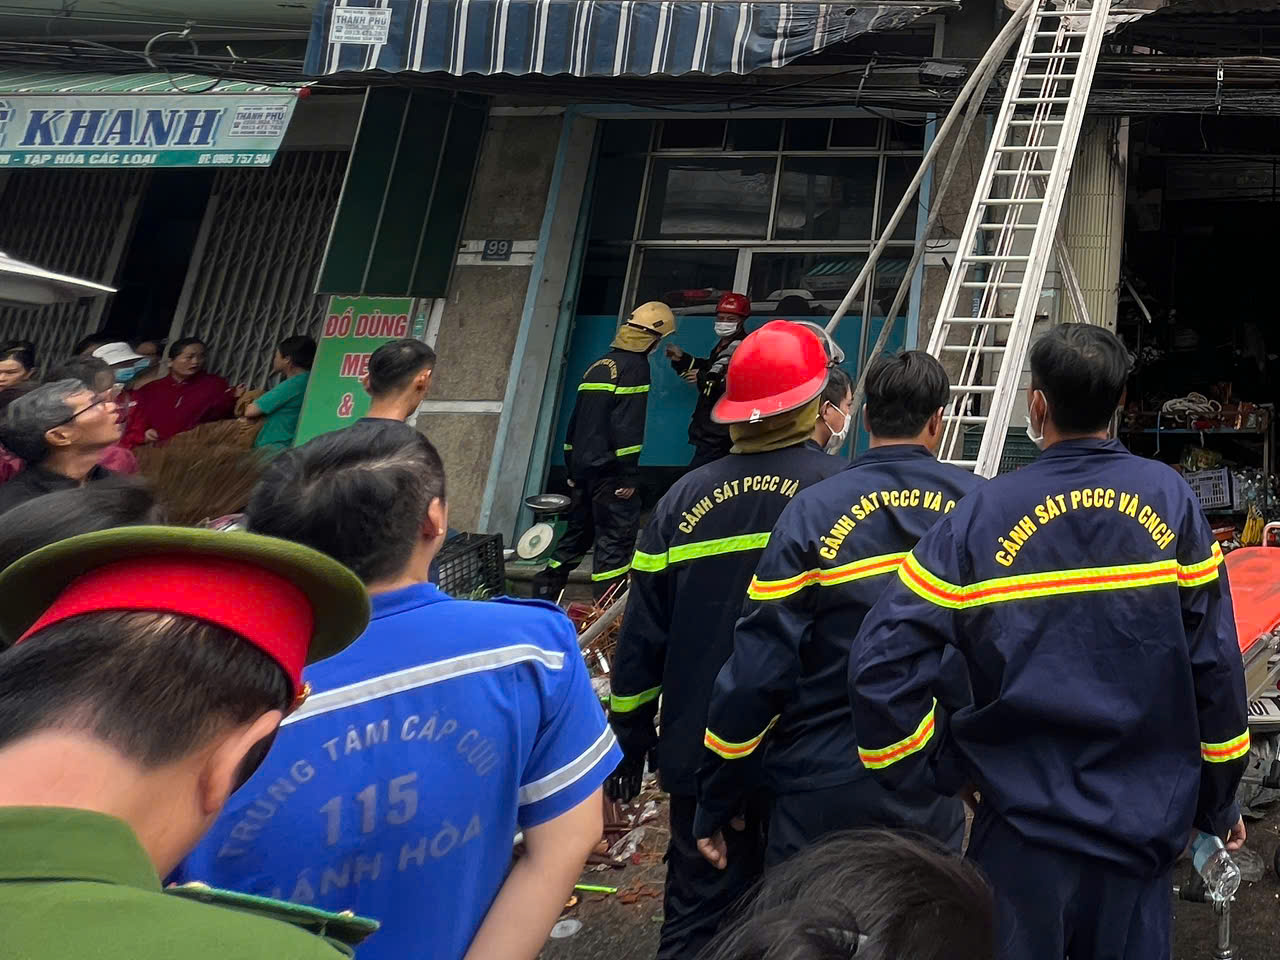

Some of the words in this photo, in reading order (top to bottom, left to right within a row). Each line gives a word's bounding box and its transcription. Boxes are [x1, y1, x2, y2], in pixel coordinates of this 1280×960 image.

[18, 109, 222, 146] KHANH
[24, 153, 52, 166] TẠP
[88, 151, 120, 164] CÁC
[121, 153, 158, 166] LOẠI
[236, 153, 254, 164] 757
[487, 241, 509, 255] 99
[338, 393, 353, 417] &
[678, 496, 714, 534] CẢNH
[713, 480, 740, 504] SÁT
[743, 475, 780, 493] PCCC
[780, 478, 800, 498] VÀ
[819, 514, 857, 560] CẢNH
[850, 492, 881, 520] SÁT
[880, 489, 921, 508] PCCC
[923, 491, 942, 512] VÀ
[995, 515, 1038, 567] CẢNH
[1034, 494, 1067, 525] SÁT
[1070, 487, 1116, 510] PCCC
[1117, 492, 1140, 518] VÀ
[1137, 505, 1176, 550] CNCH
[321, 719, 391, 762] TÂM
[319, 772, 419, 846] 115
